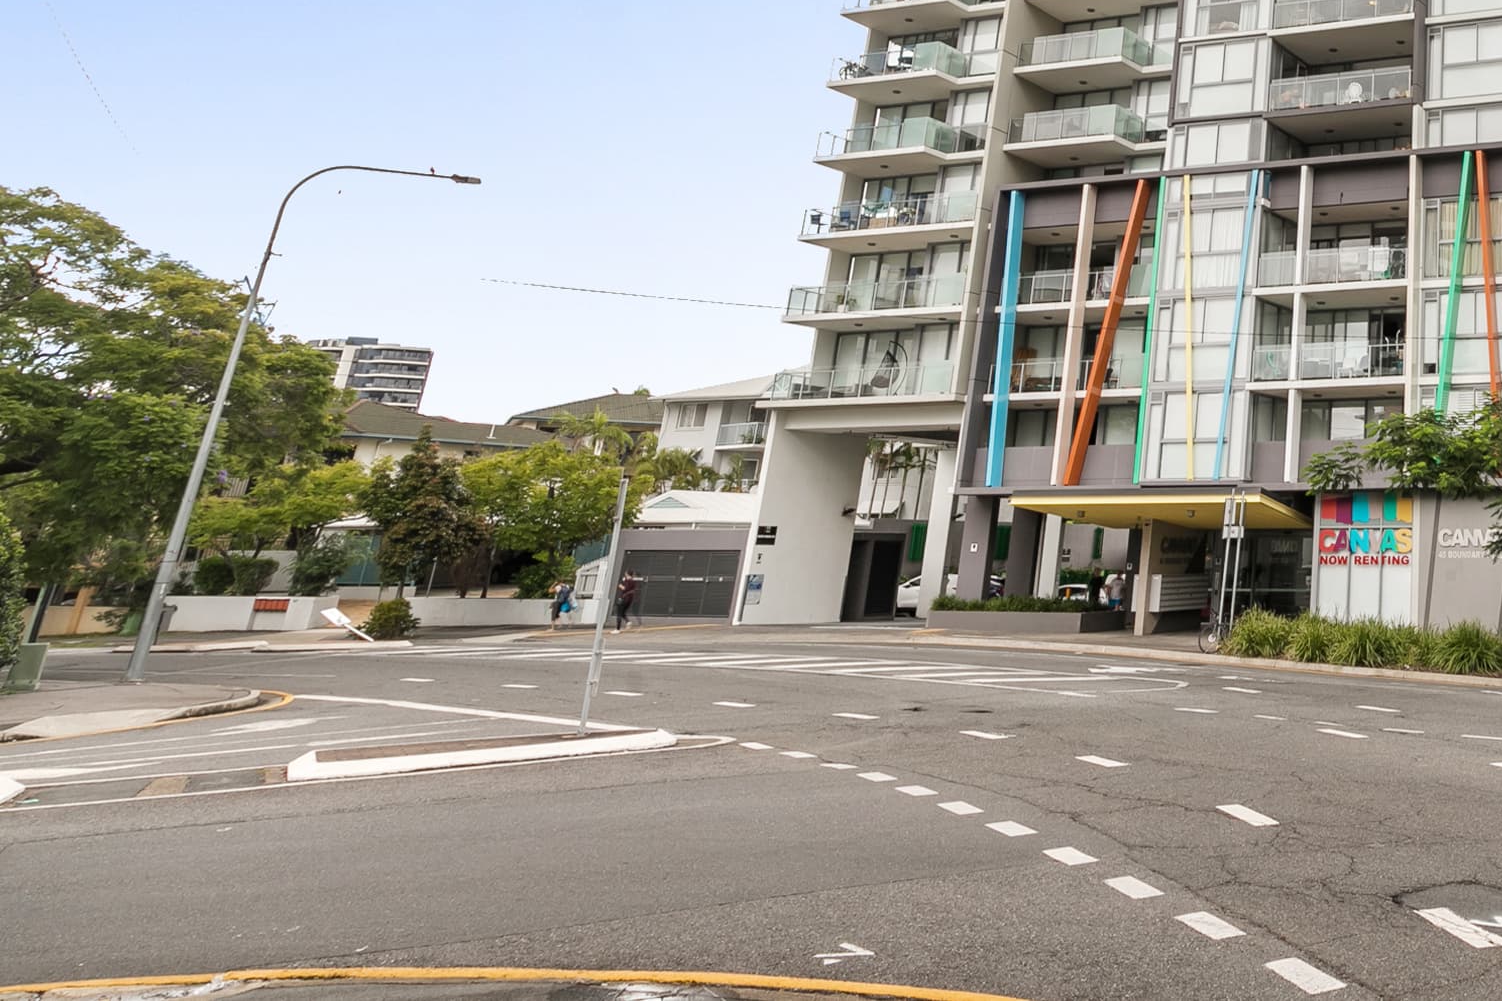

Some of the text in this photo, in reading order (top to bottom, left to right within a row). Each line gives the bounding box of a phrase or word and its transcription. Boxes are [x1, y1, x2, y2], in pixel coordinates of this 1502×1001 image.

[1319, 528, 1413, 554] CANVAS
[1320, 555, 1410, 566] NOW RENTING
